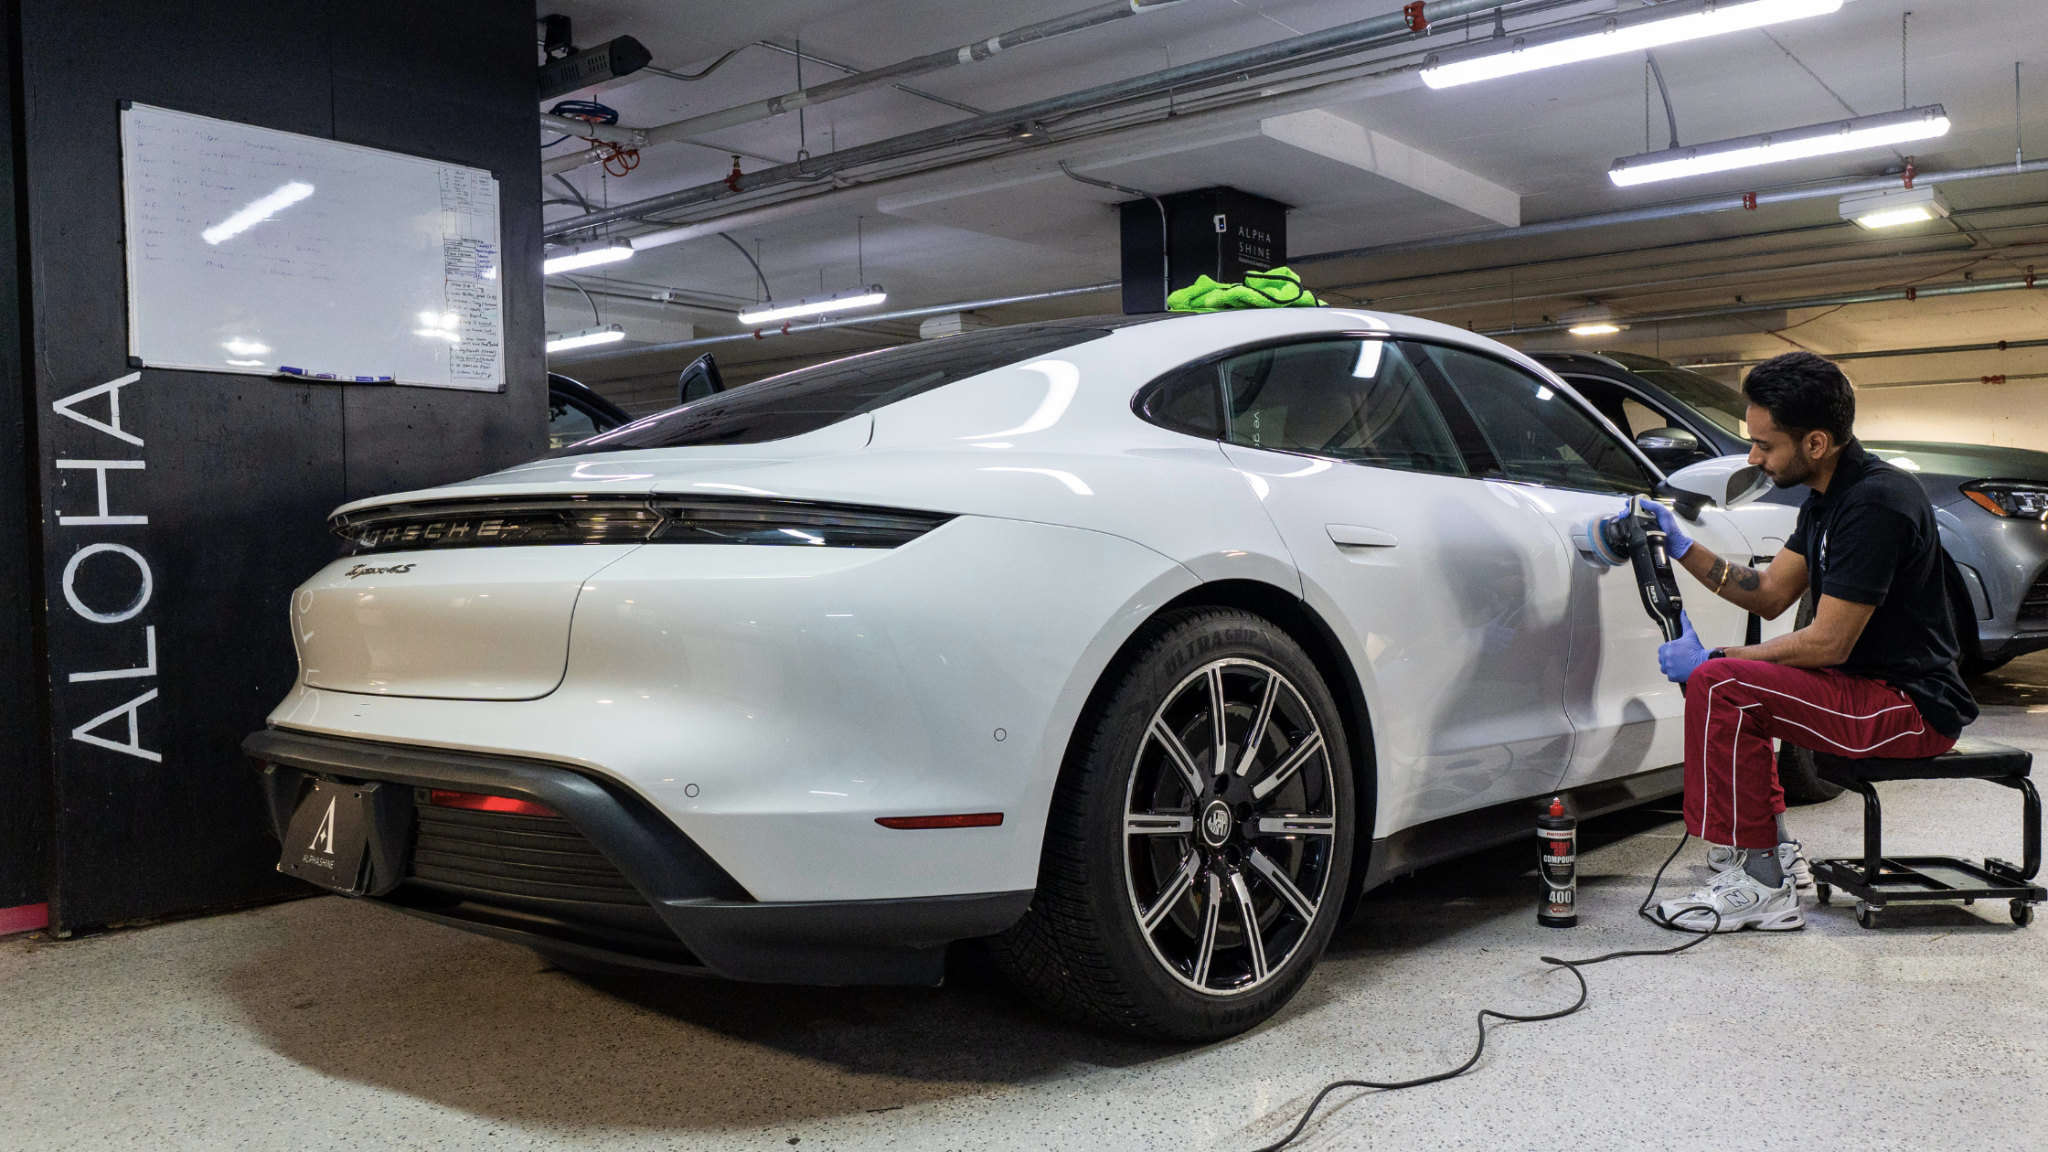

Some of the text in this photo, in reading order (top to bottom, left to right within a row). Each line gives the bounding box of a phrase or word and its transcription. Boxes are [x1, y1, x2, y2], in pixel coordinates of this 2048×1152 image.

[1238, 226, 1271, 243] ALPHA
[1239, 241, 1271, 260] SHINE
[53, 371, 162, 763] ALOHA
[1548, 890, 1572, 904] 400
